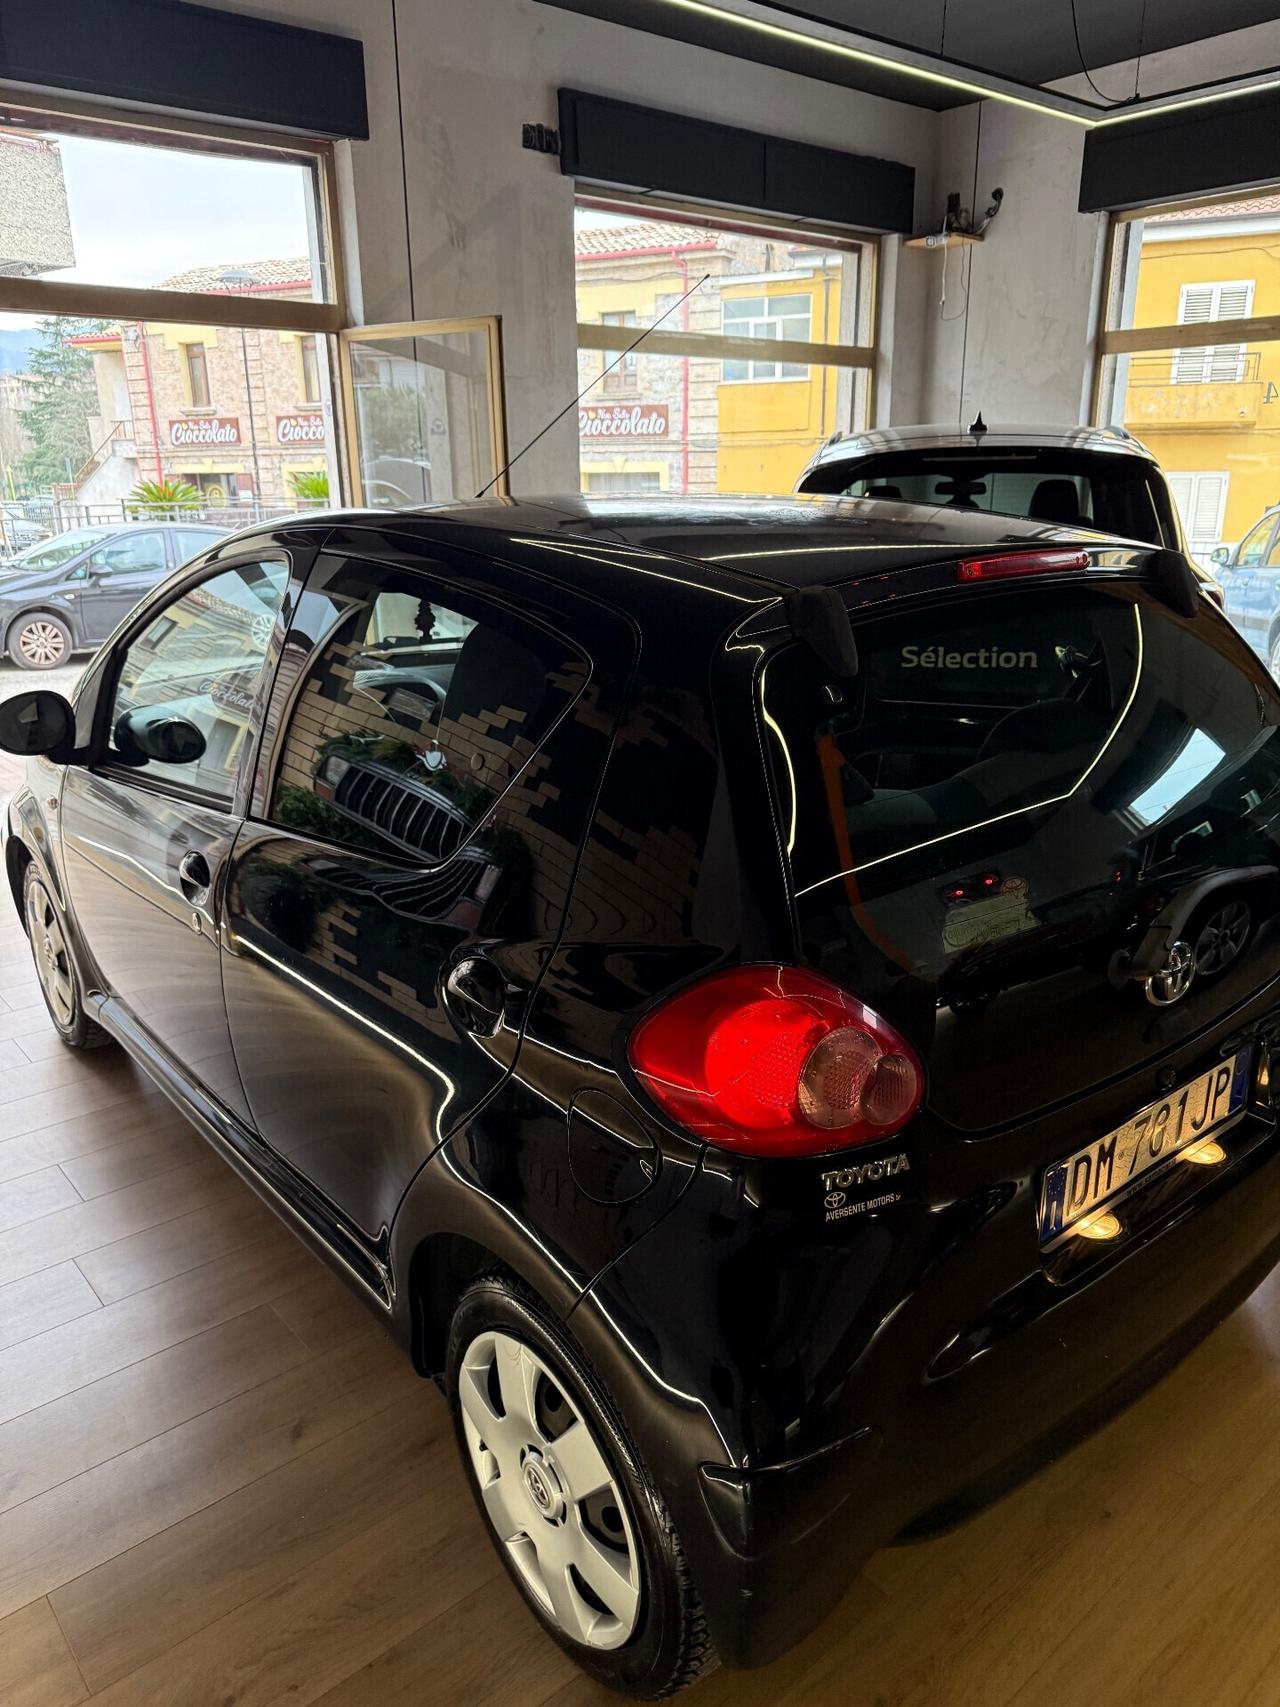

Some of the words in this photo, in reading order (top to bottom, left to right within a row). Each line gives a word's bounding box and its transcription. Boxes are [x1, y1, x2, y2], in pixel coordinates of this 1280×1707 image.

[171, 419, 237, 445] Cioccolato
[901, 646, 1038, 669] Sélection
[821, 1153, 910, 1191] TOYOTA
[1067, 1135, 1117, 1216] DM
[825, 1202, 865, 1221] AVERSENTE
[866, 1193, 895, 1210] MOTORS
